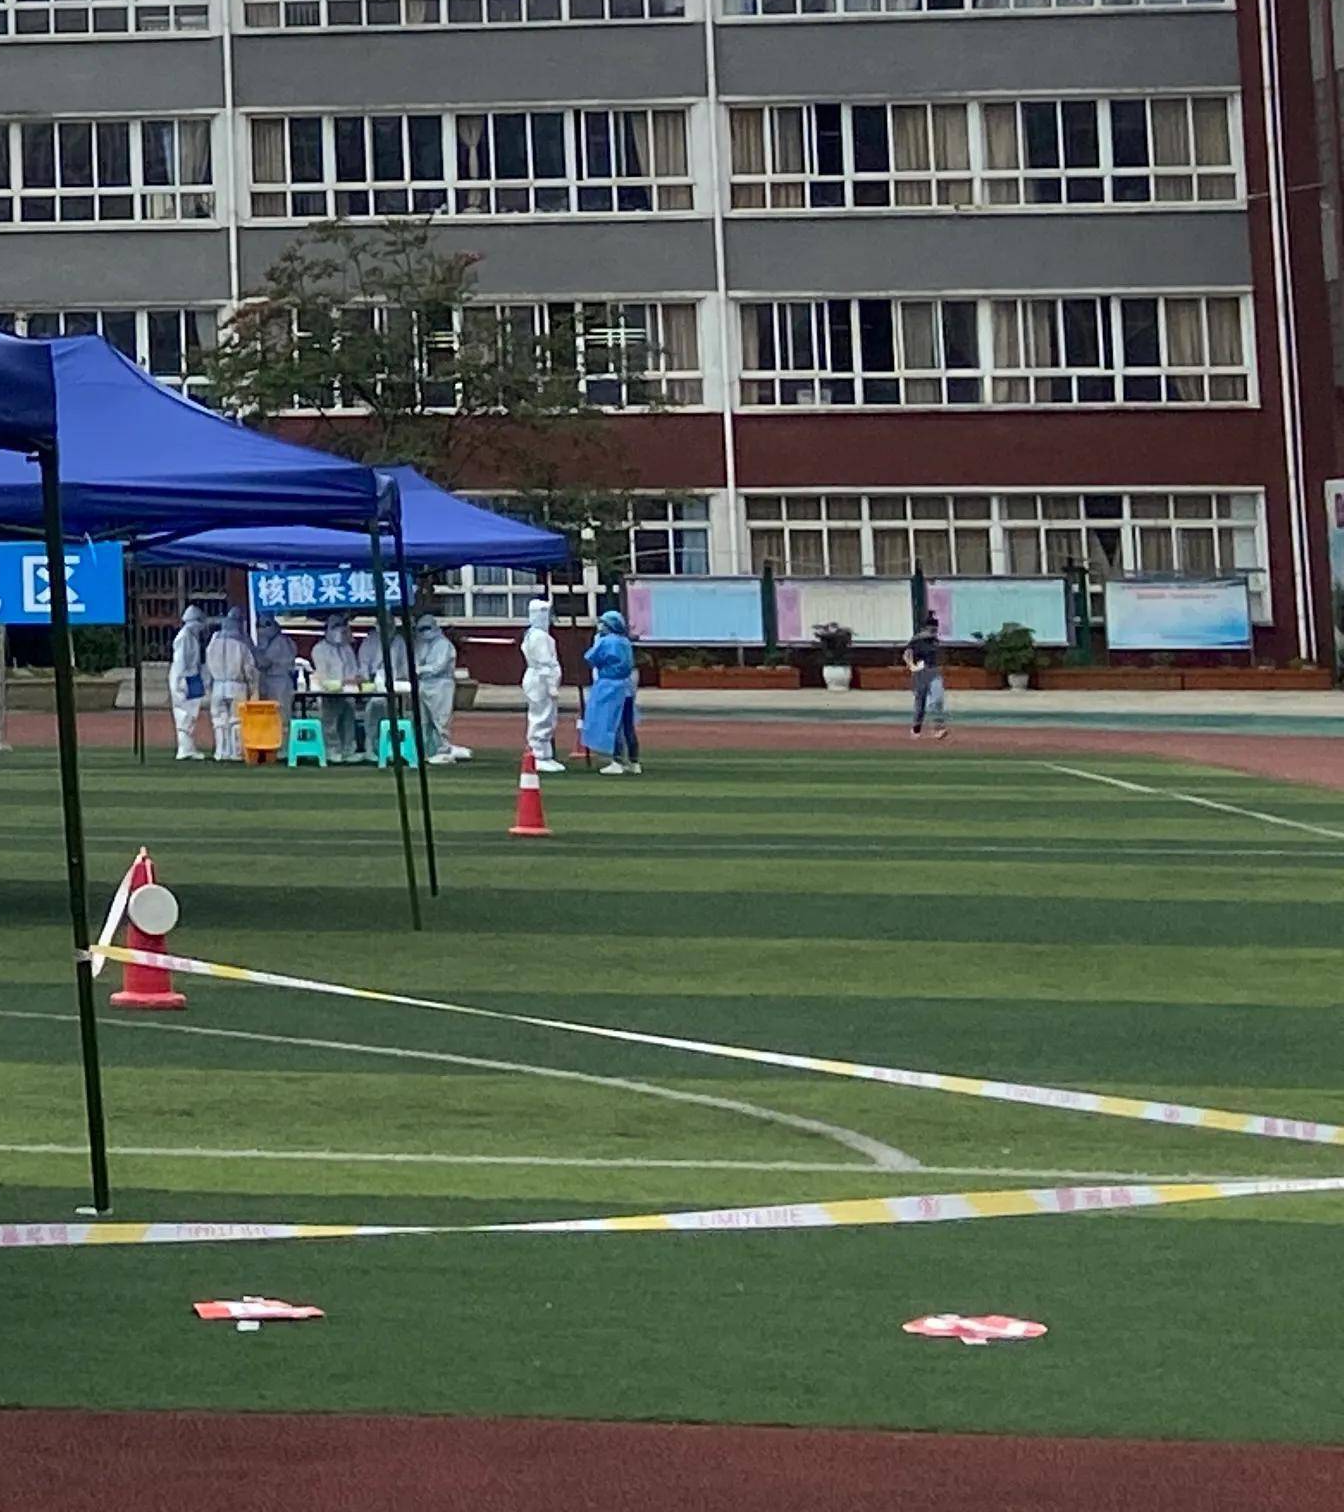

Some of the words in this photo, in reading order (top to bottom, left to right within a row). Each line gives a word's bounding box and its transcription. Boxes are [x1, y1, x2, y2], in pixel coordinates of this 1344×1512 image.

[258, 571, 402, 606] 核酸采集区
